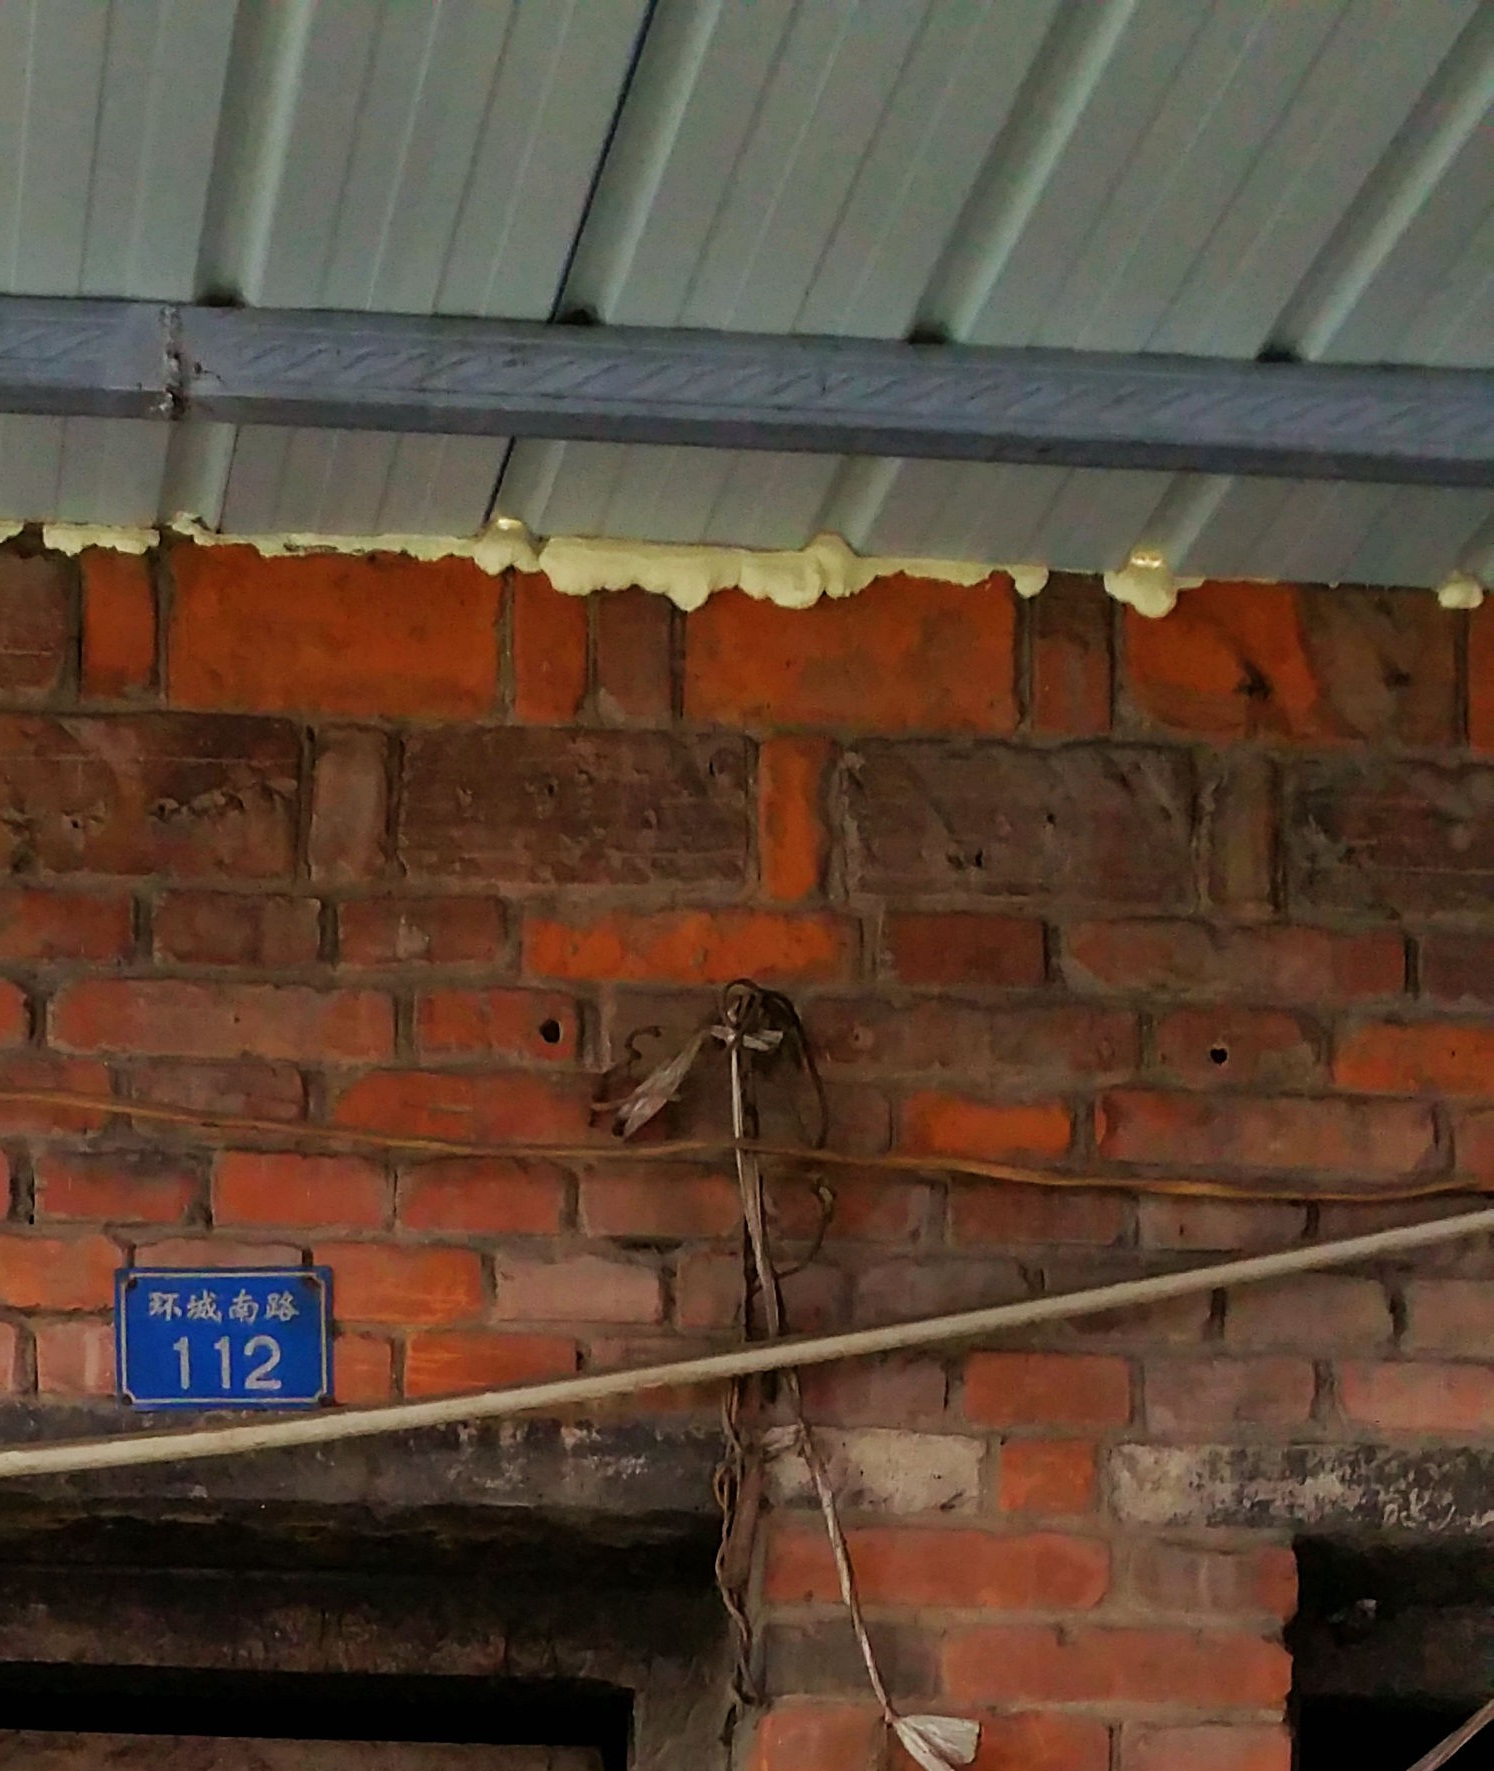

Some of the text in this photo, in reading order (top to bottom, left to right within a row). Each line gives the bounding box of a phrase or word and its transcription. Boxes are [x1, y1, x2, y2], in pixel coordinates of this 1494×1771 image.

[148, 1289, 299, 1324] 环城南路
[173, 1335, 282, 1390] 112
